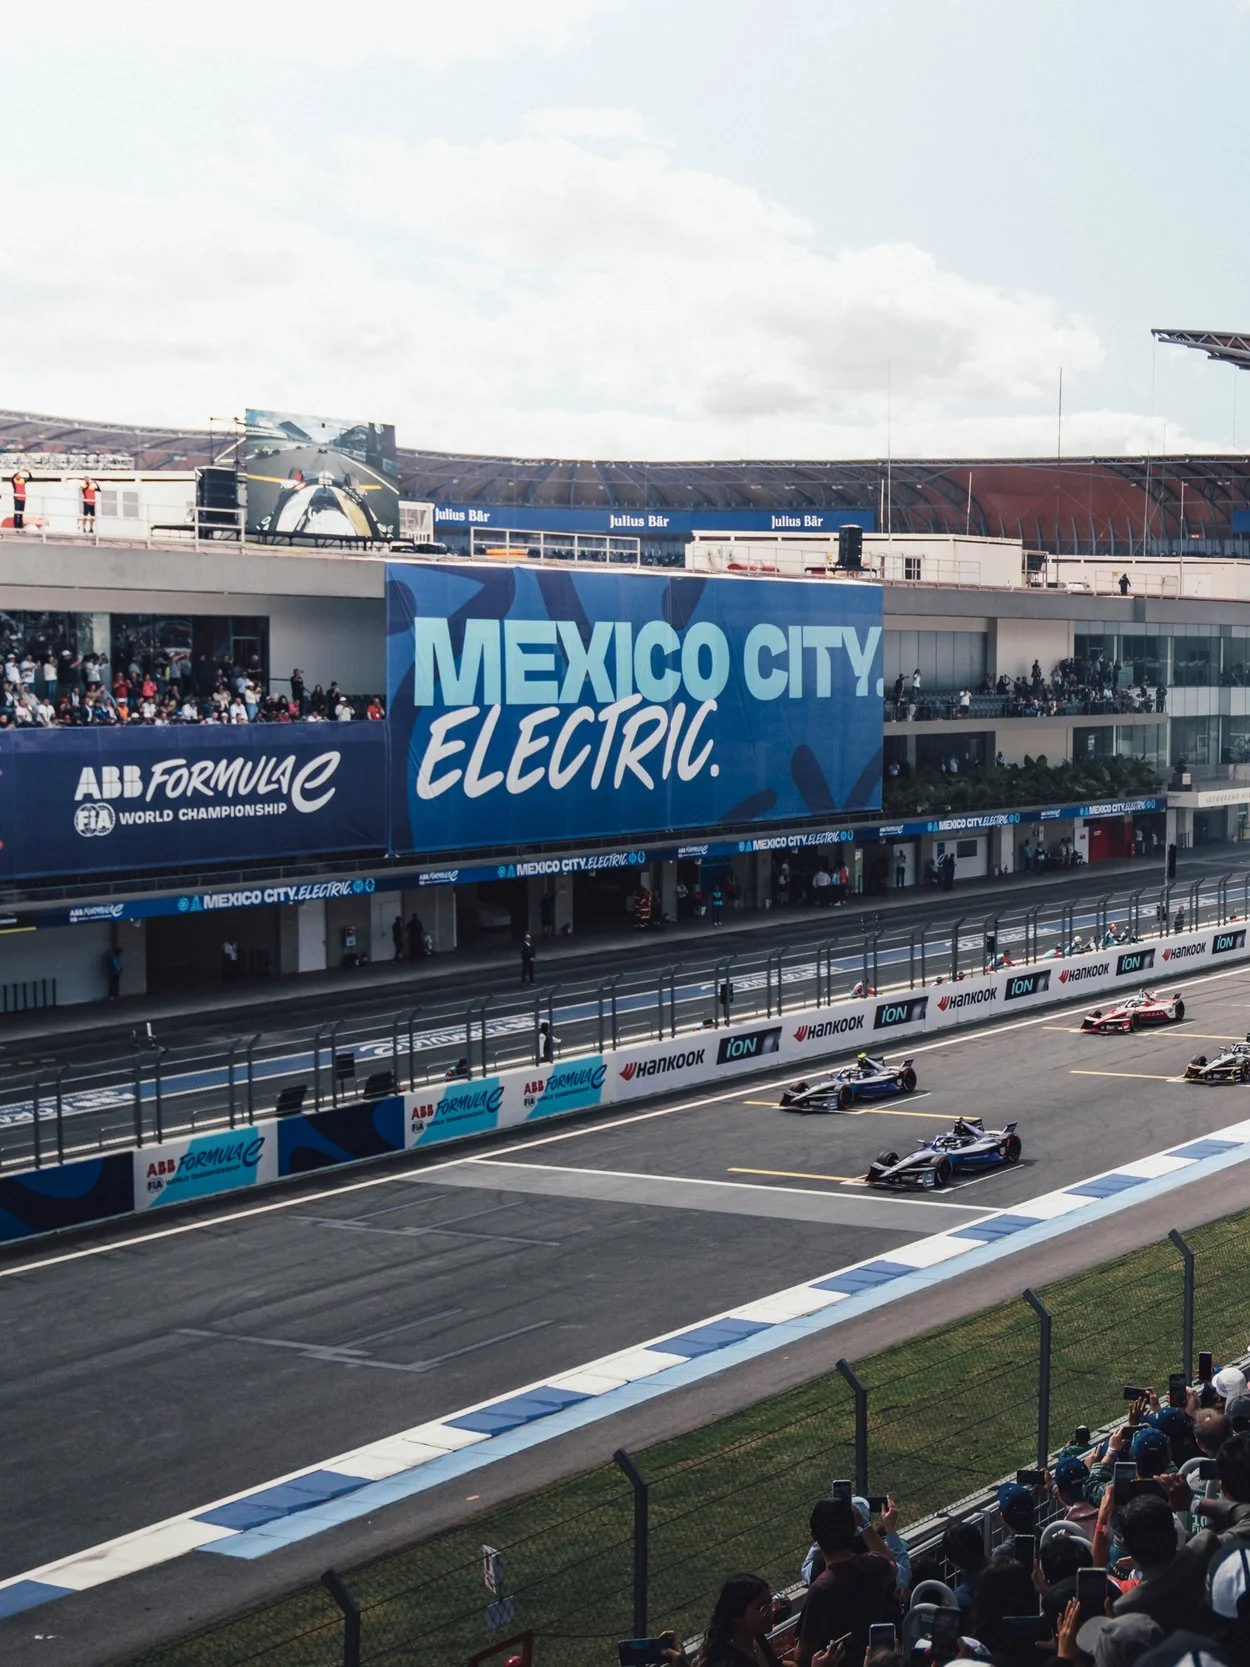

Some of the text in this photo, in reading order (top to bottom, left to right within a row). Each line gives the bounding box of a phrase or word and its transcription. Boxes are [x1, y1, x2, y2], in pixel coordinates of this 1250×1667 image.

[436, 508, 490, 522] Julius Bär
[610, 515, 669, 528] Julius Bär
[772, 515, 823, 529] Julius Bär
[414, 617, 730, 706] MEXICO
[417, 694, 720, 800] ELECTRIC.
[74, 765, 143, 800] ABB
[146, 754, 296, 802] FORMULA
[120, 810, 173, 825] WORLD
[178, 802, 287, 821] CHAMPIONSHIP
[1089, 805, 1111, 815] MEXICO
[939, 818, 966, 830] MEXICO
[753, 837, 787, 850] MEXICO
[516, 861, 560, 876] MEXICO
[204, 891, 262, 909] MEXICO
[726, 1037, 757, 1058] iON
[882, 1005, 907, 1024] iON
[1012, 978, 1034, 995] iON
[1122, 955, 1140, 971] iON
[1217, 936, 1234, 950] iON
[524, 1080, 544, 1096] ABB
[545, 1068, 591, 1094] FORMULA
[411, 1104, 434, 1120] ABB
[434, 1090, 486, 1118] FORMULA
[147, 1159, 176, 1178] ABB
[177, 1142, 244, 1173] FORMULA
